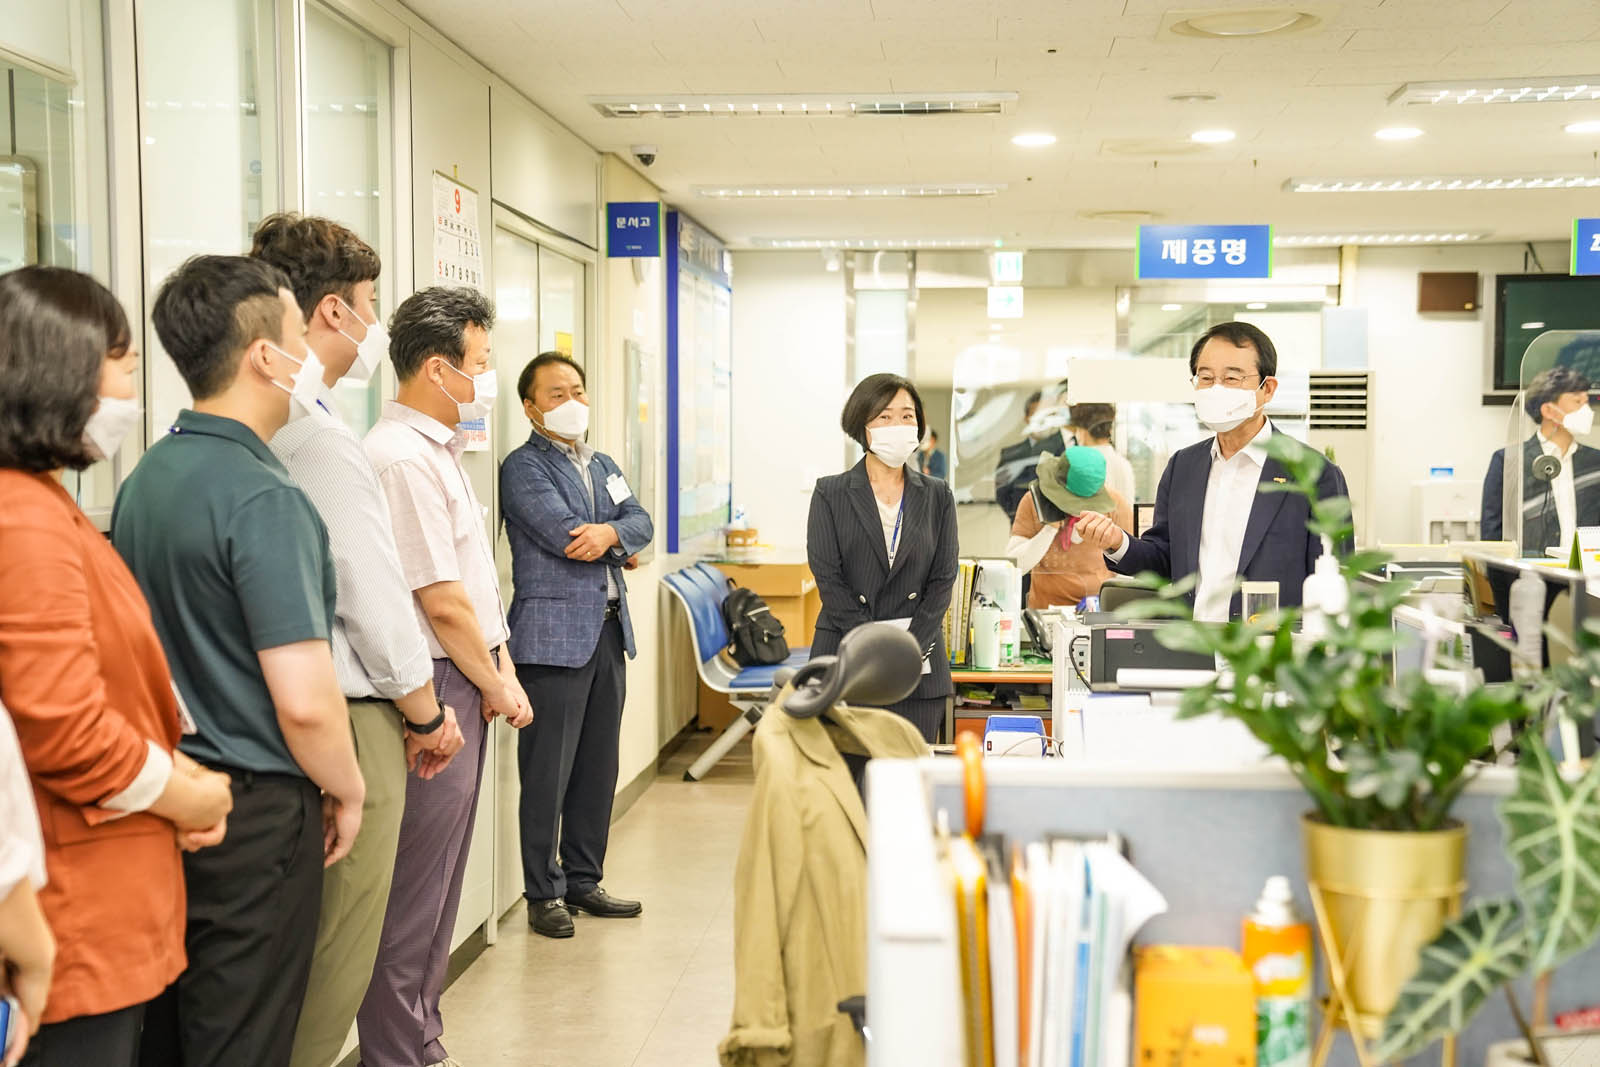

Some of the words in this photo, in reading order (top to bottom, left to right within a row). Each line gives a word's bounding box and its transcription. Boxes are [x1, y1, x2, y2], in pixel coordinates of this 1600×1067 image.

[454, 188, 461, 214] 9
[616, 216, 650, 229] 문서고
[464, 241, 469, 255] 2
[1161, 238, 1247, 266] 제증명
[438, 260, 443, 275] 5
[445, 263, 449, 277] 6
[451, 264, 456, 278] 7
[458, 267, 463, 281] 8
[465, 269, 470, 282] 9
